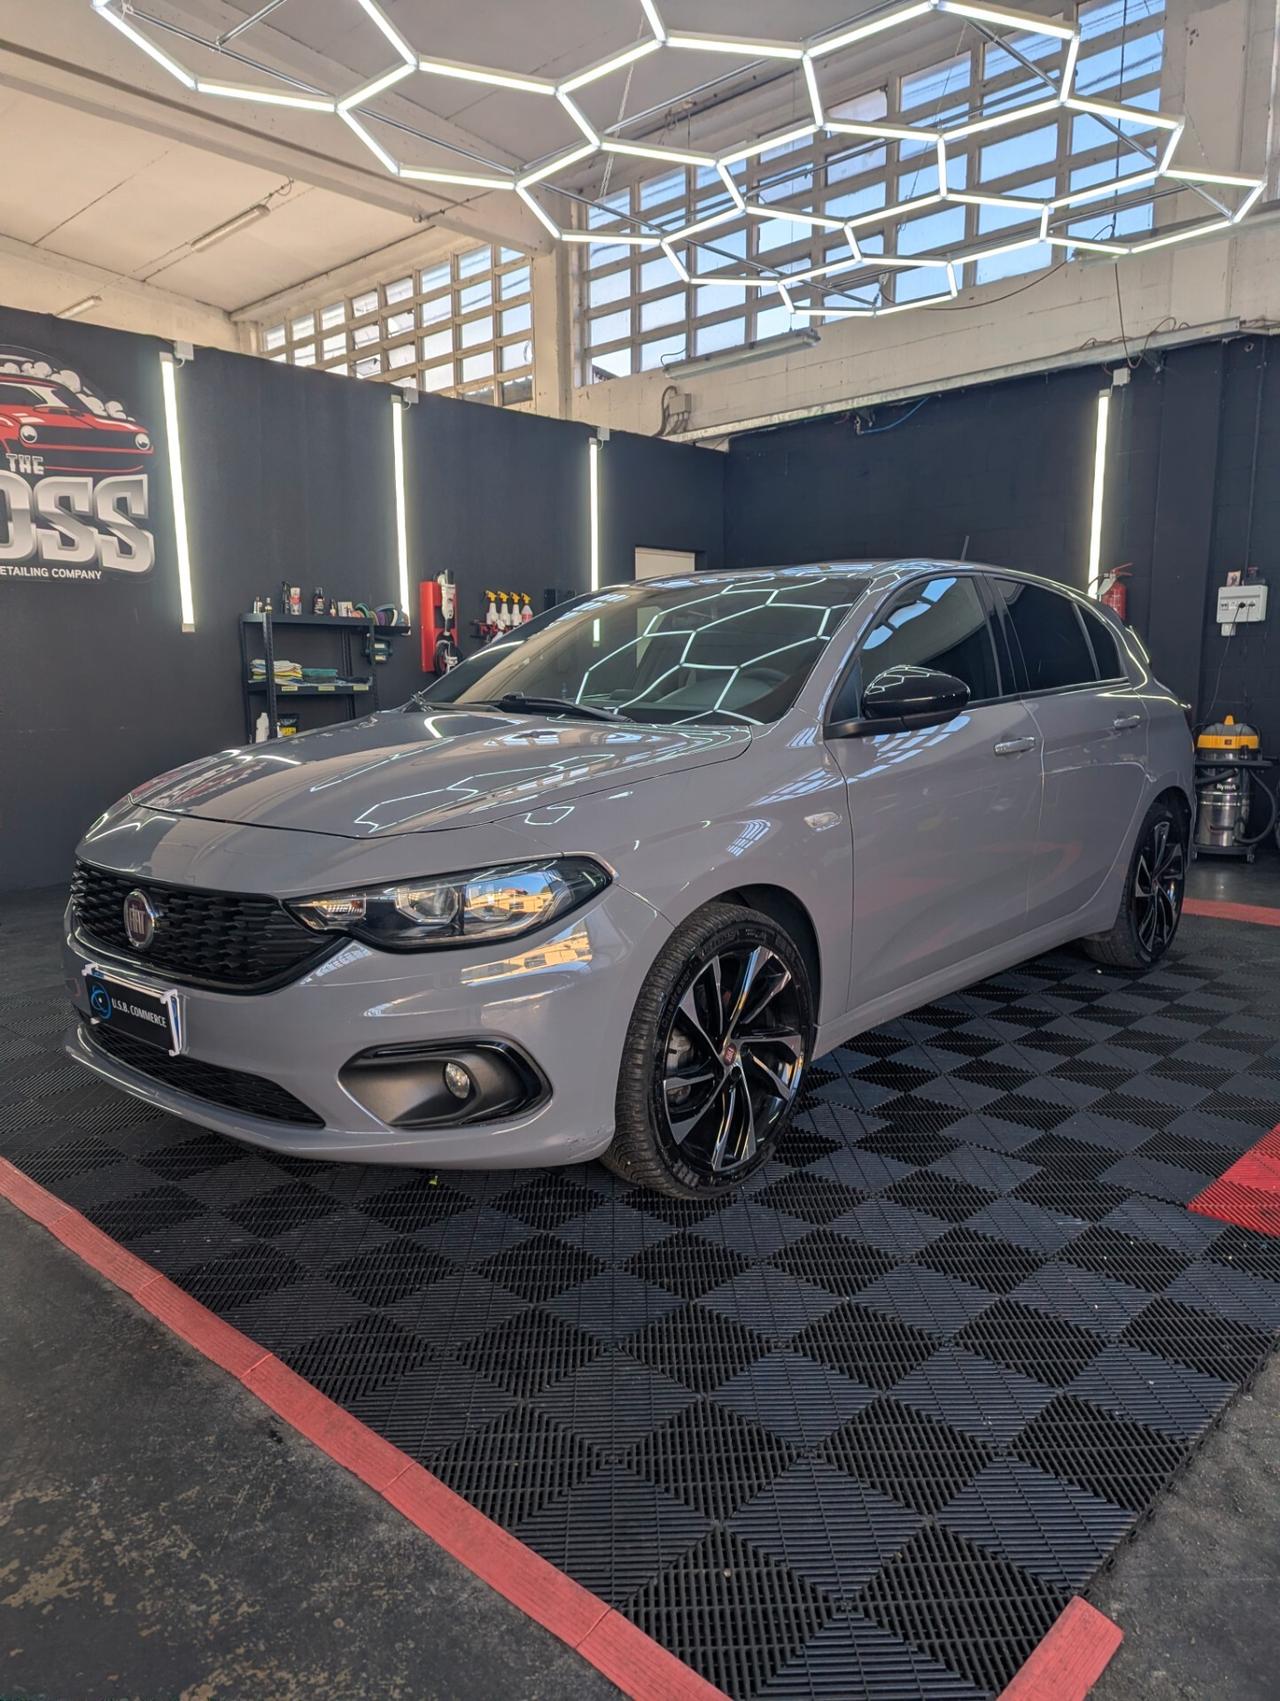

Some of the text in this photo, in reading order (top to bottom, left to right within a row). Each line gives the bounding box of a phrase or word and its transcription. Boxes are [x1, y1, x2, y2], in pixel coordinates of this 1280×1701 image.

[6, 454, 44, 475] THE
[51, 568, 102, 579] COMPANY
[128, 906, 146, 935] FIAT
[111, 997, 167, 1028] U.S.B. COMMERCE
